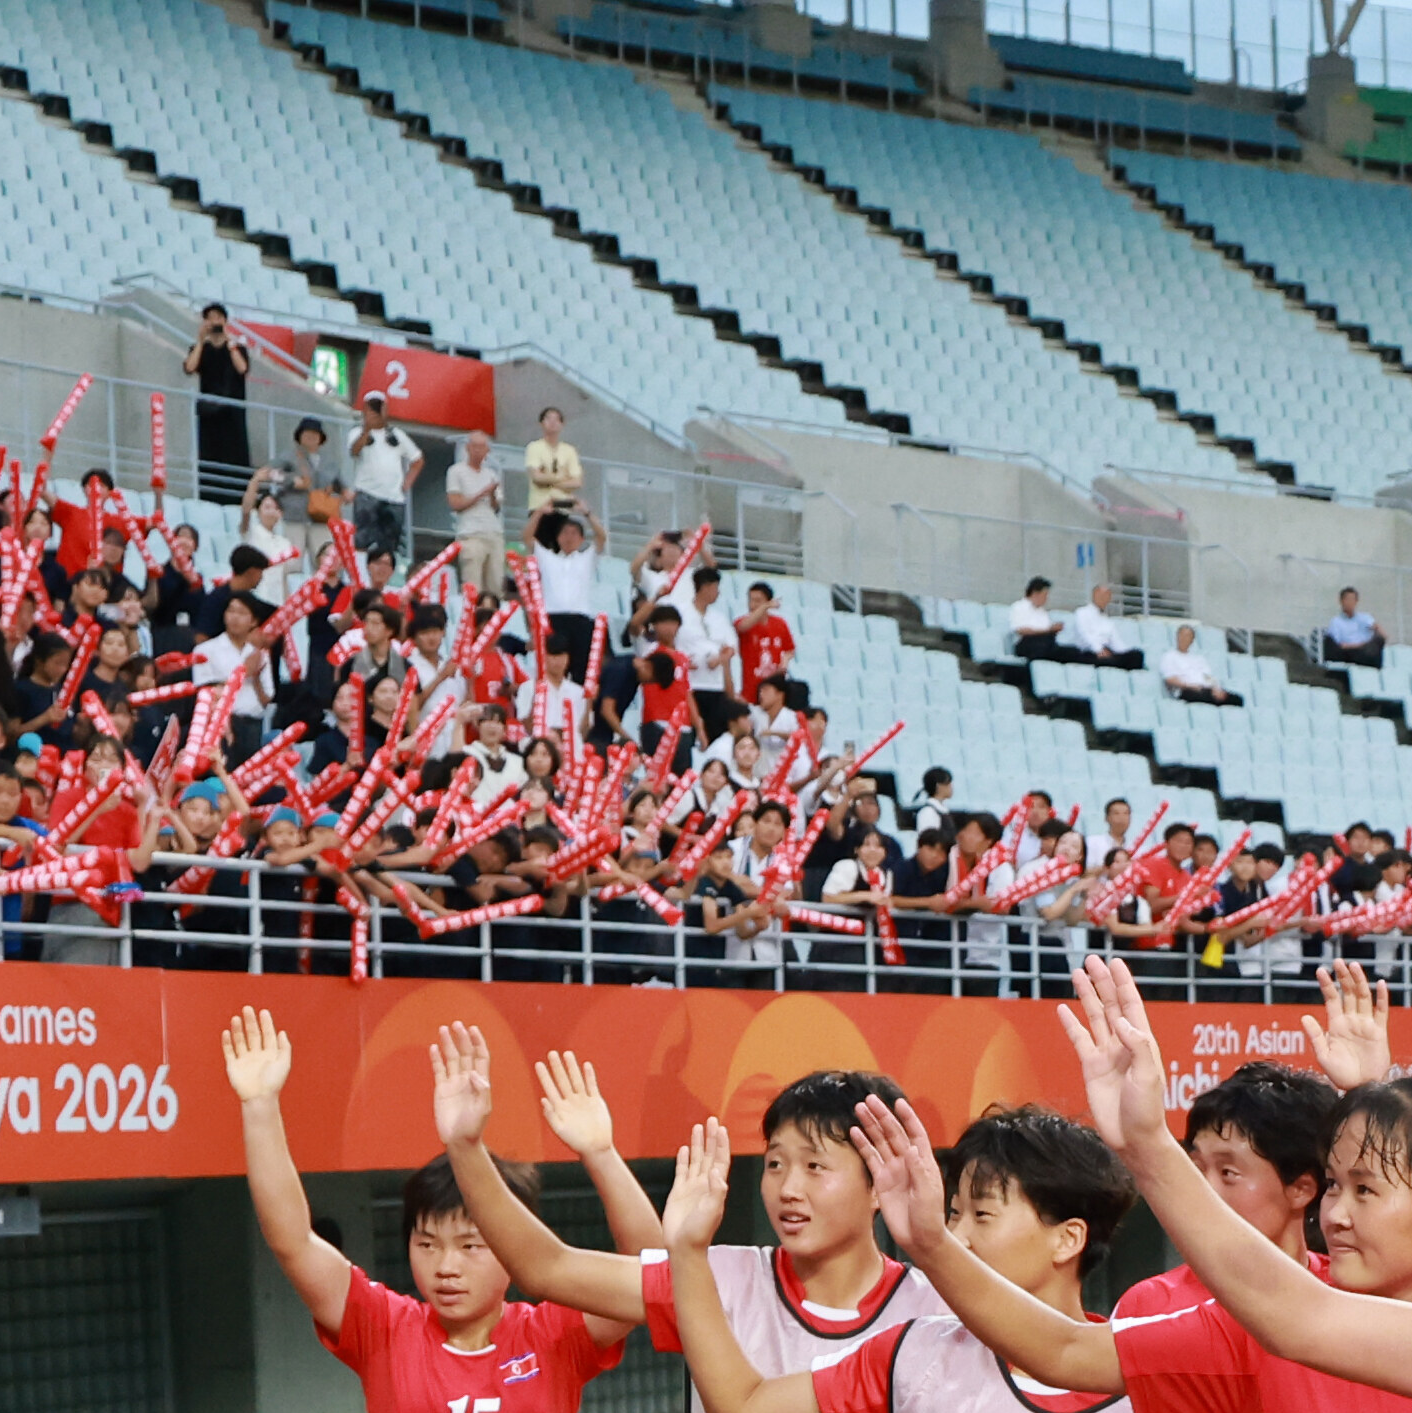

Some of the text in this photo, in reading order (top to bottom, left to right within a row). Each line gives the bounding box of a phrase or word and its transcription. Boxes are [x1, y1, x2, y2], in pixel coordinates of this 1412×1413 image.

[385, 360, 410, 399] 2
[1192, 1021, 1305, 1056] 20th Asian
[54, 1062, 179, 1133] 2026
